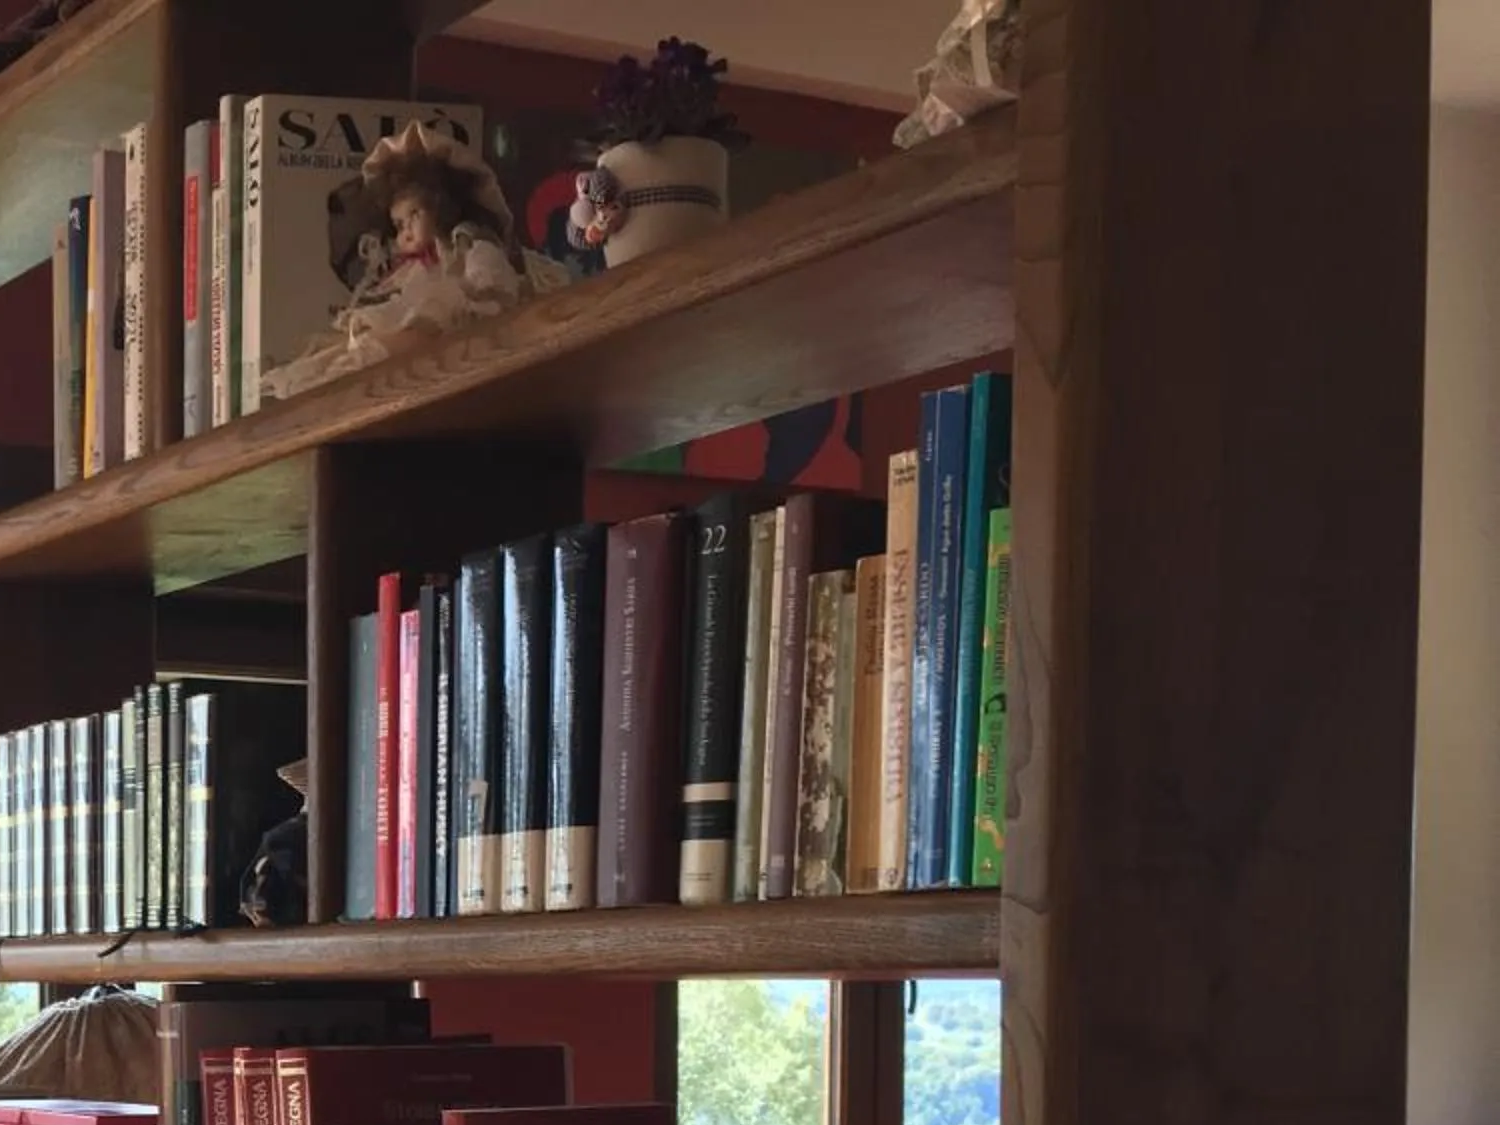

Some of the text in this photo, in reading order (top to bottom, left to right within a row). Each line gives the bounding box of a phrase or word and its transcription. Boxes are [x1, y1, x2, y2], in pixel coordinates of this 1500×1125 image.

[701, 526, 726, 555] 22
[435, 692, 449, 784] SIBERIAN
[435, 788, 447, 856] HUSKY
